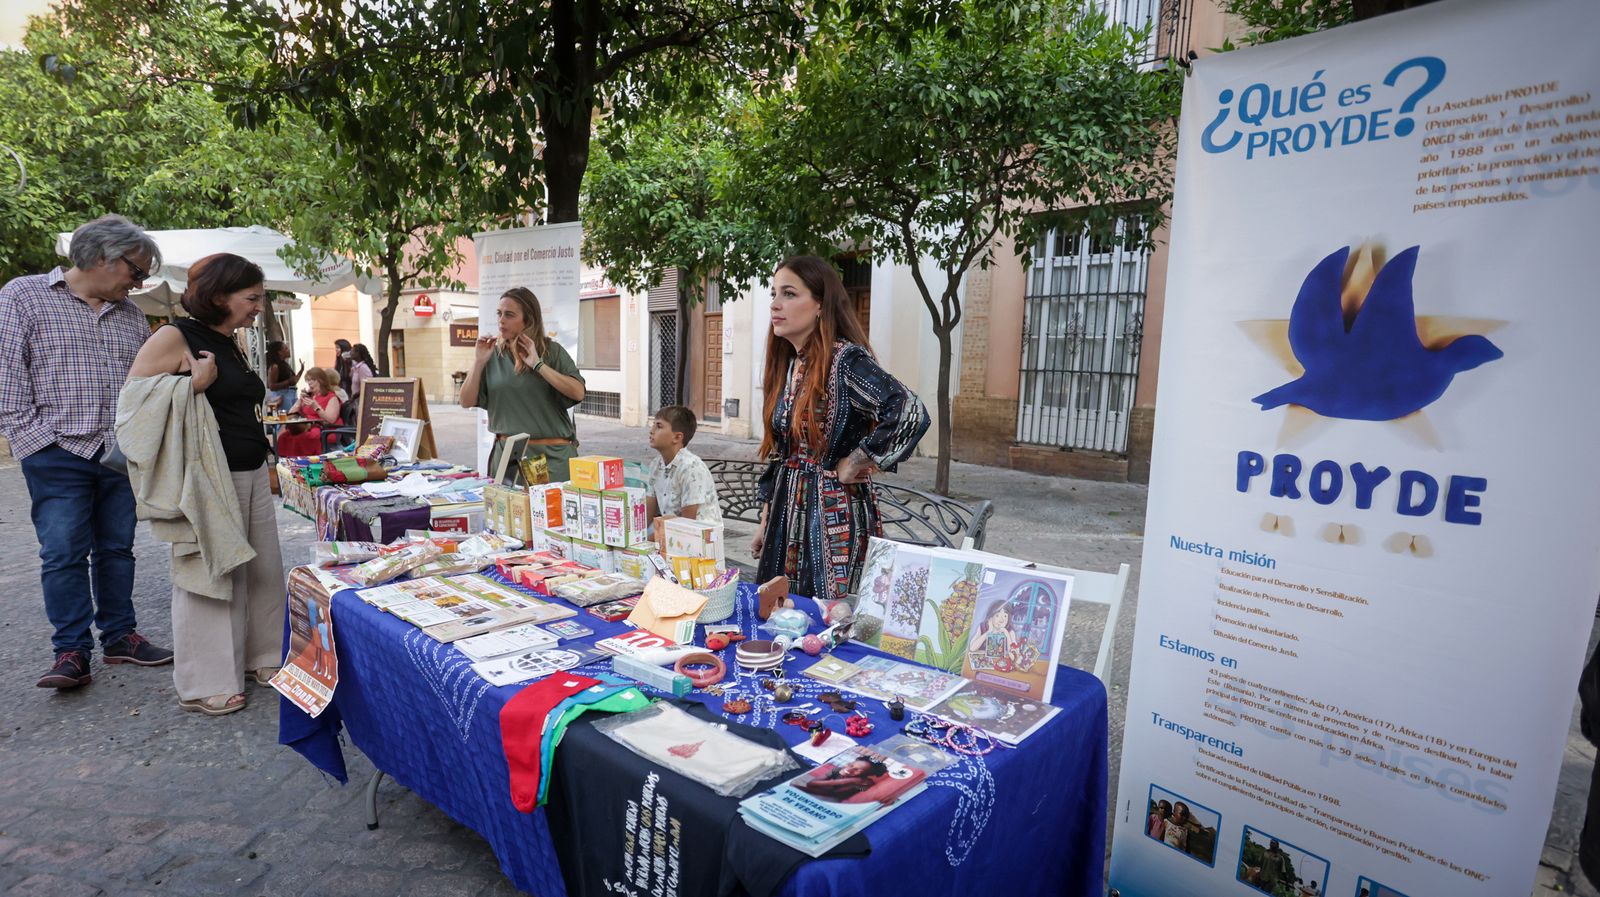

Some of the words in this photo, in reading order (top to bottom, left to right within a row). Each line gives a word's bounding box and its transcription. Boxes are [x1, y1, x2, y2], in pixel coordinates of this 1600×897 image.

[1201, 69, 1326, 153] ¿Qué
[1338, 84, 1371, 107] es
[1425, 112, 1488, 131] (Promoción
[1519, 92, 1592, 115] Desarrollo)
[1427, 105, 1440, 115] La
[1443, 93, 1502, 112] Asociación
[1505, 80, 1560, 99] PROYDE
[1423, 133, 1455, 148] ONGD
[1459, 130, 1474, 142] sin
[1479, 127, 1503, 139] afán
[1507, 122, 1521, 134] de
[1526, 118, 1560, 132] lucro,
[1420, 152, 1439, 164] año
[1450, 145, 1484, 159] 1988
[1494, 143, 1514, 153] con
[1525, 139, 1540, 148] un
[1477, 160, 1487, 171] la
[1489, 152, 1552, 172] promoción
[1556, 152, 1563, 163] y
[1567, 148, 1579, 160] el
[1415, 185, 1428, 196] de
[1431, 182, 1447, 194] las
[1450, 178, 1501, 193] personas
[1506, 175, 1513, 185] y
[1517, 166, 1599, 183] comunidades
[1413, 199, 1446, 213] países
[1447, 191, 1529, 209] empobrecidos.
[495, 250, 513, 263] Ciudad
[514, 251, 523, 264] por
[524, 249, 530, 261] el
[530, 247, 556, 260] Comercio
[557, 246, 575, 259] Justo
[1236, 450, 1487, 526] PROYDE
[1170, 536, 1223, 559] Nuestra
[1229, 549, 1277, 570] misión
[1219, 583, 1252, 598] Realización
[1262, 593, 1295, 608] Proyectos
[1306, 602, 1344, 618] Desarrollo.
[1221, 566, 1251, 580] Educación
[1251, 573, 1266, 584] para
[1274, 579, 1309, 593] Desarrollo
[1316, 587, 1369, 606] Sensibilización.
[1217, 598, 1246, 612] Incidencia
[1246, 605, 1271, 618] política.
[617, 631, 666, 650] 10
[1213, 628, 1237, 641] Difusión
[1238, 635, 1247, 644] del
[1248, 639, 1277, 653] Comercio
[1278, 648, 1299, 658] Justo.
[1215, 614, 1246, 628] Promoción
[1248, 621, 1257, 631] del
[1258, 625, 1299, 641] voluntariado.
[1159, 634, 1215, 663] Estamos
[1220, 656, 1237, 669] en
[1151, 712, 1244, 757] Transparencia
[1206, 687, 1231, 702] principal
[1240, 697, 1267, 713] PROYDE
[1276, 709, 1297, 723] centra
[1297, 717, 1306, 725] en
[1314, 721, 1349, 739] educación
[1350, 734, 1360, 743] en
[1360, 736, 1385, 752] África.
[1207, 677, 1220, 687] Este
[1223, 683, 1256, 699] (Rumanía).
[1259, 693, 1271, 703] Por
[1283, 701, 1309, 715] número
[1312, 710, 1321, 718] de
[1323, 715, 1360, 732] proyectos
[1372, 729, 1382, 738] de
[1385, 734, 1420, 751] recursos
[1424, 746, 1473, 768] destinados,
[1490, 766, 1513, 781] labor
[1209, 668, 1218, 676] 43
[1218, 672, 1238, 683] países
[1238, 677, 1246, 685] de
[1247, 680, 1268, 691] cuatro
[1268, 686, 1307, 703] continentes:
[1309, 698, 1325, 710] Asia
[1326, 704, 1341, 716] (7),
[1342, 709, 1373, 725] América
[1375, 719, 1397, 733] (17),
[1399, 726, 1424, 741] África
[1425, 734, 1447, 748] (18)
[1456, 745, 1467, 754] en
[1469, 748, 1501, 765] Europa
[1502, 759, 1517, 769] del
[1214, 704, 1237, 719] España,
[1240, 712, 1267, 728] PROYDE
[1269, 723, 1292, 737] cuenta
[1294, 731, 1307, 741] con
[1309, 736, 1324, 748] más
[1326, 743, 1336, 752] de
[1339, 748, 1352, 757] 50
[1355, 753, 1377, 766] sedes
[1380, 760, 1407, 776] locales
[1410, 773, 1421, 781] en
[1424, 775, 1447, 789] trece
[1198, 746, 1227, 763] Declarada
[1227, 756, 1250, 771] entidad
[1259, 769, 1283, 785] Utilidad
[1283, 779, 1307, 794] Pública
[1307, 788, 1316, 797] en
[1318, 793, 1342, 807] 1998.
[782, 796, 794, 808] DE
[793, 801, 828, 821] VERANO
[784, 788, 843, 819] VOLUNTARIADO
[1195, 770, 1212, 782] sobre
[1218, 779, 1256, 800] cumplimiento
[1265, 799, 1296, 817] principios
[1296, 811, 1305, 819] de
[1305, 815, 1328, 831] acción,
[1329, 825, 1374, 849] organización
[1381, 847, 1412, 864] gestión.
[1196, 761, 1227, 778] Certificado
[1242, 779, 1273, 797] Fundación
[1274, 791, 1298, 807] Lealtad
[1298, 801, 1307, 810] de
[1369, 830, 1398, 846] Buenas
[1399, 841, 1437, 863] Prácticas
[1437, 858, 1449, 867] de
[1450, 862, 1462, 873] las
